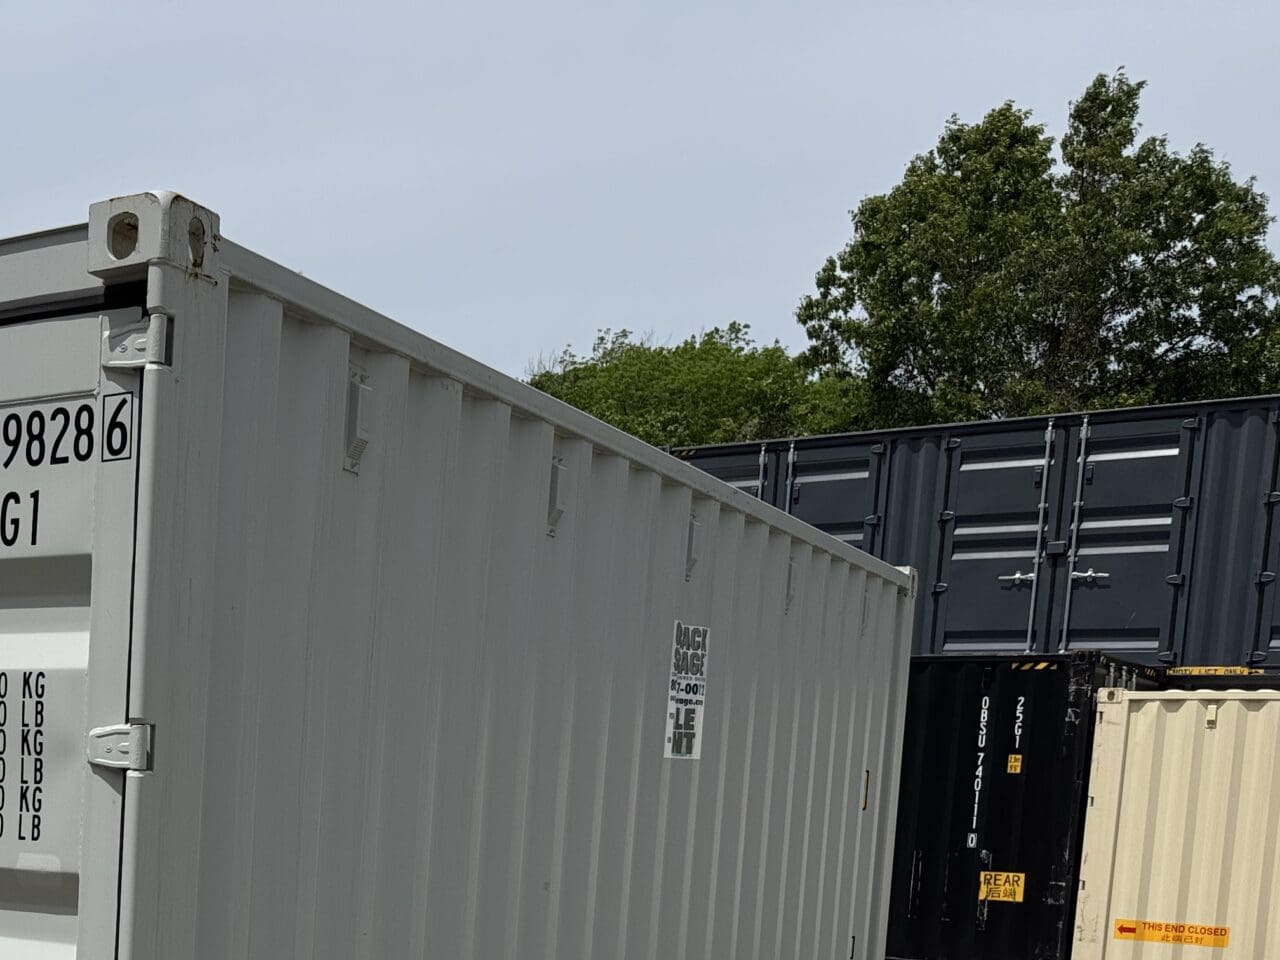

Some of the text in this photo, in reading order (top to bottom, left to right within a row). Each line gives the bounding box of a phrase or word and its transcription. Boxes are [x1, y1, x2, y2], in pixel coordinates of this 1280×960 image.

[104, 395, 131, 459] 6
[22, 671, 46, 699] KG
[21, 700, 44, 728] LB
[977, 696, 991, 748] OBSU
[1014, 696, 1025, 749] 25G1
[21, 728, 44, 756] KG
[20, 757, 44, 785] LB
[19, 785, 43, 813] KG
[972, 753, 985, 830] 740111
[18, 813, 41, 841] LB
[983, 873, 1020, 887] REAR
[1142, 922, 1227, 937] THIS END CLOSED
